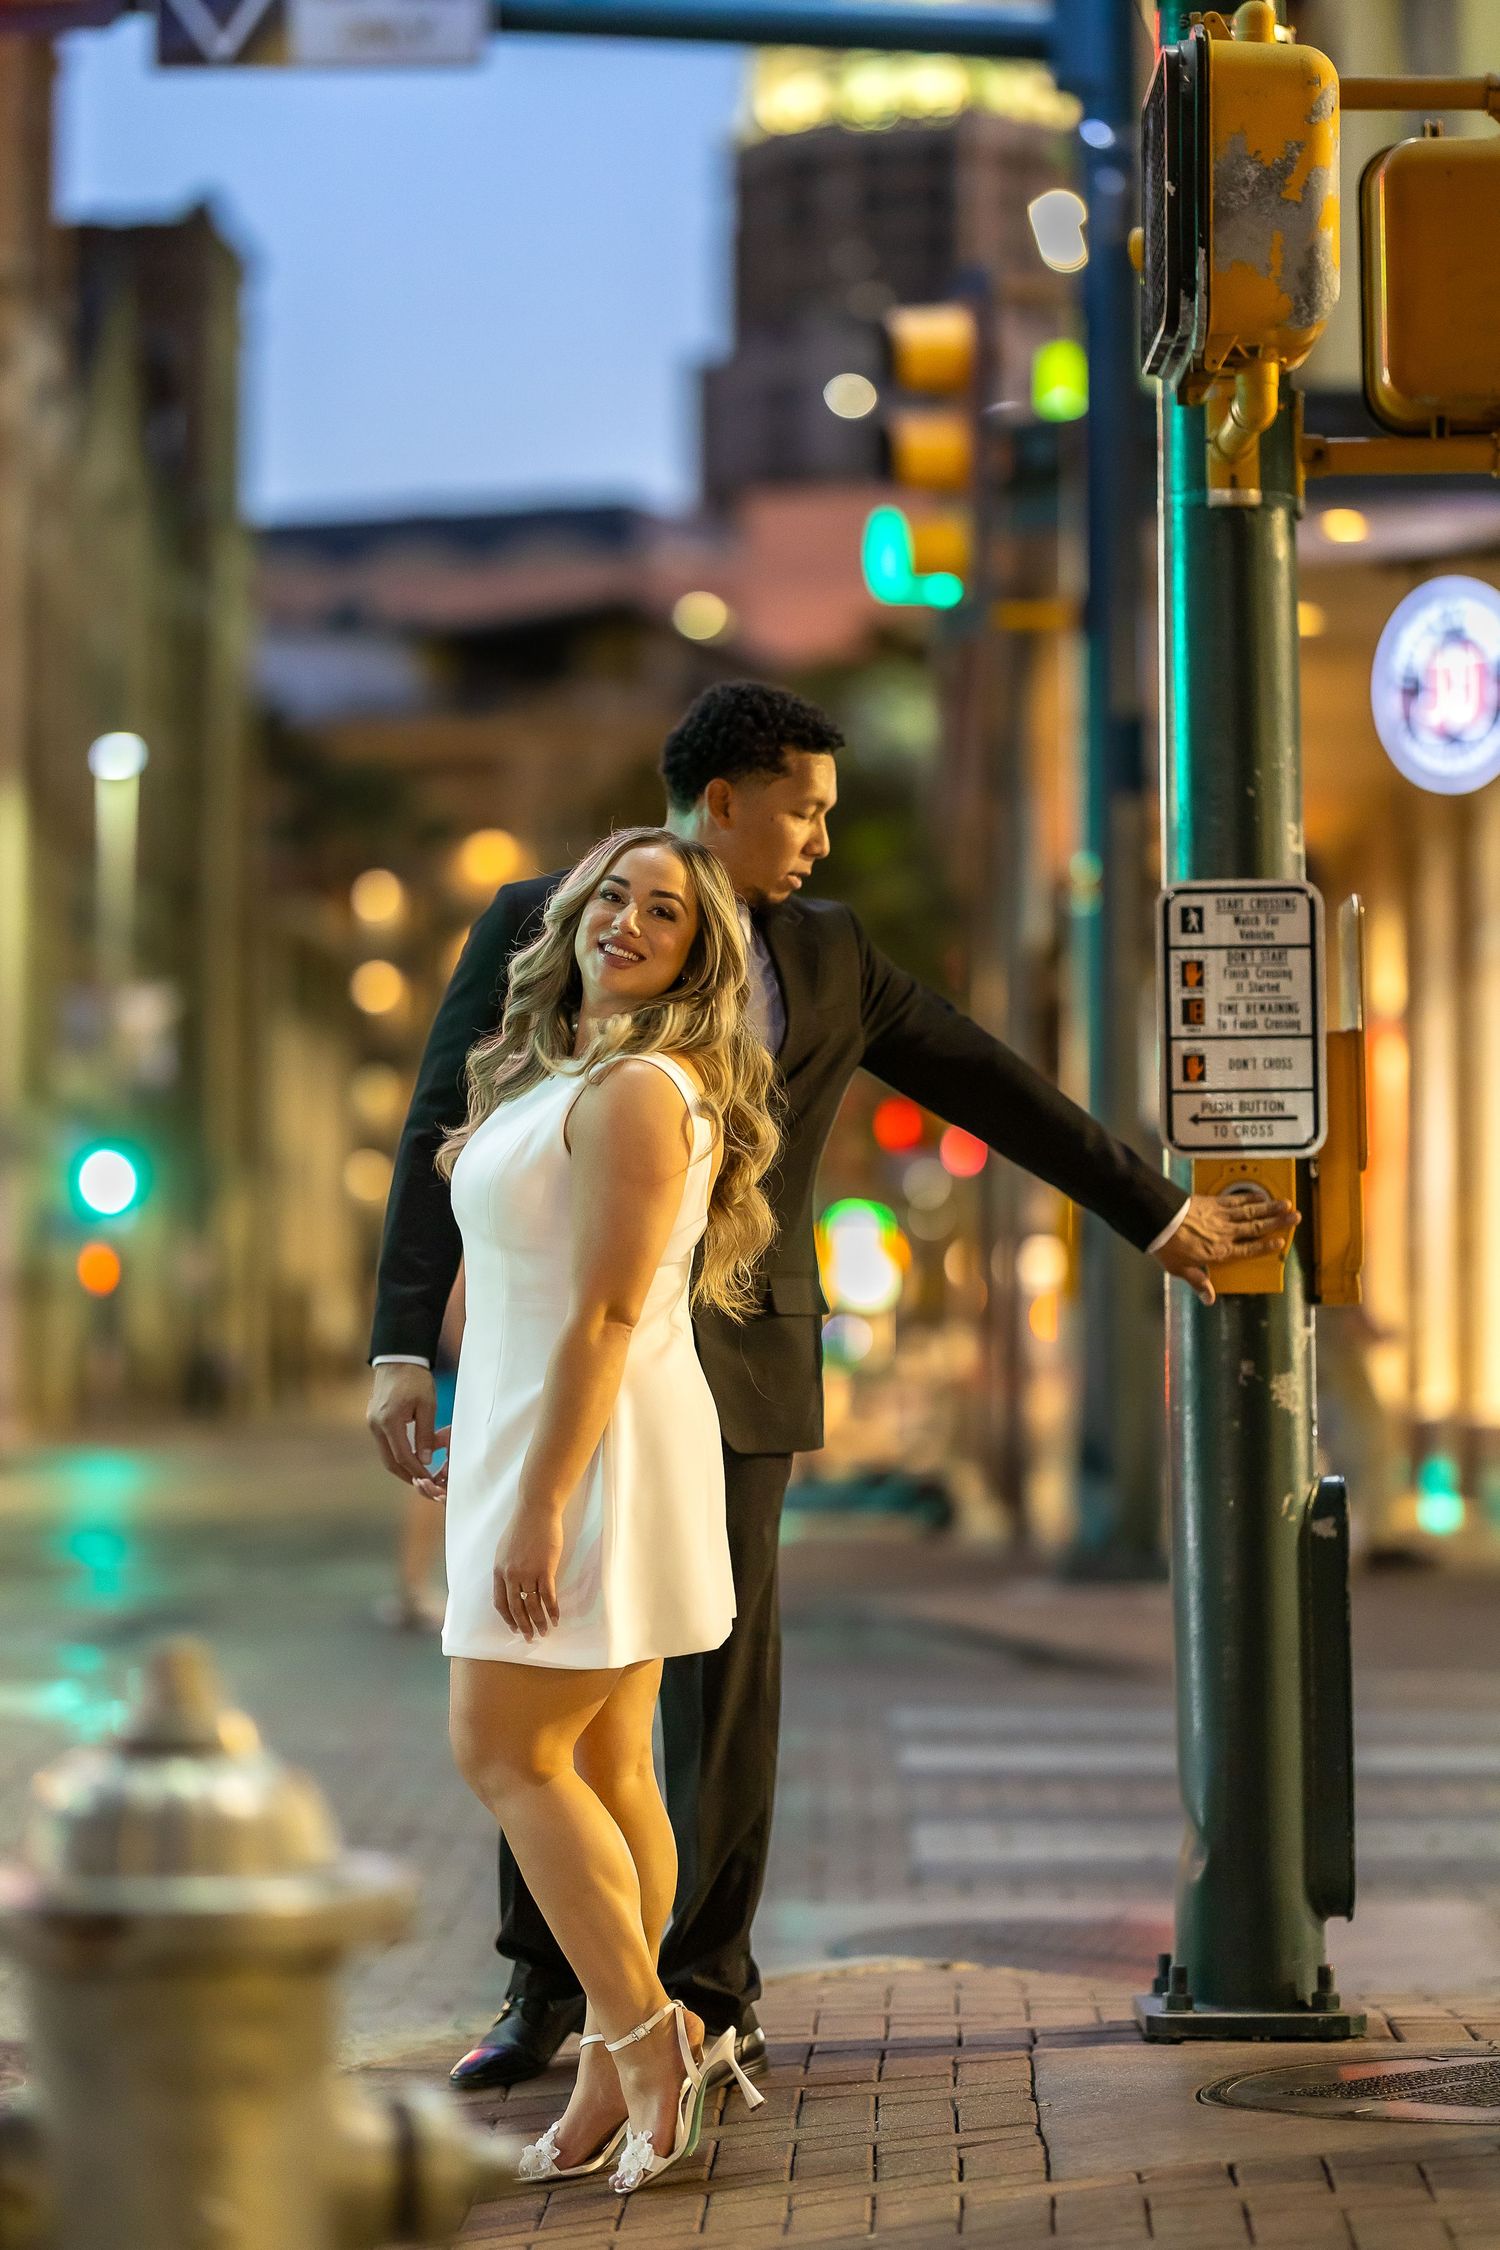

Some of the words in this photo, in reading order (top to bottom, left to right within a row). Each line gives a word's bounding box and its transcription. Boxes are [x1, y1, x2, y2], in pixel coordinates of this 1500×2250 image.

[1215, 898, 1244, 910] START
[1250, 897, 1297, 910] CROSSING
[1239, 930, 1275, 940] Vehicles
[1227, 951, 1255, 963] DON'T
[1260, 951, 1288, 963] START
[1255, 967, 1293, 981] Crossing
[1248, 982, 1280, 993] Started
[1218, 1003, 1238, 1015] TIME
[1246, 1002, 1300, 1014] REMAINING
[1264, 1017, 1300, 1031] Crossing
[1228, 1058, 1257, 1070] DON'T
[1263, 1057, 1293, 1069] CROSS
[1201, 1102, 1233, 1114] PUSH
[1239, 1100, 1285, 1113] BUTTON
[1214, 1126, 1228, 1138] TO
[1234, 1125, 1274, 1138] CROSS
